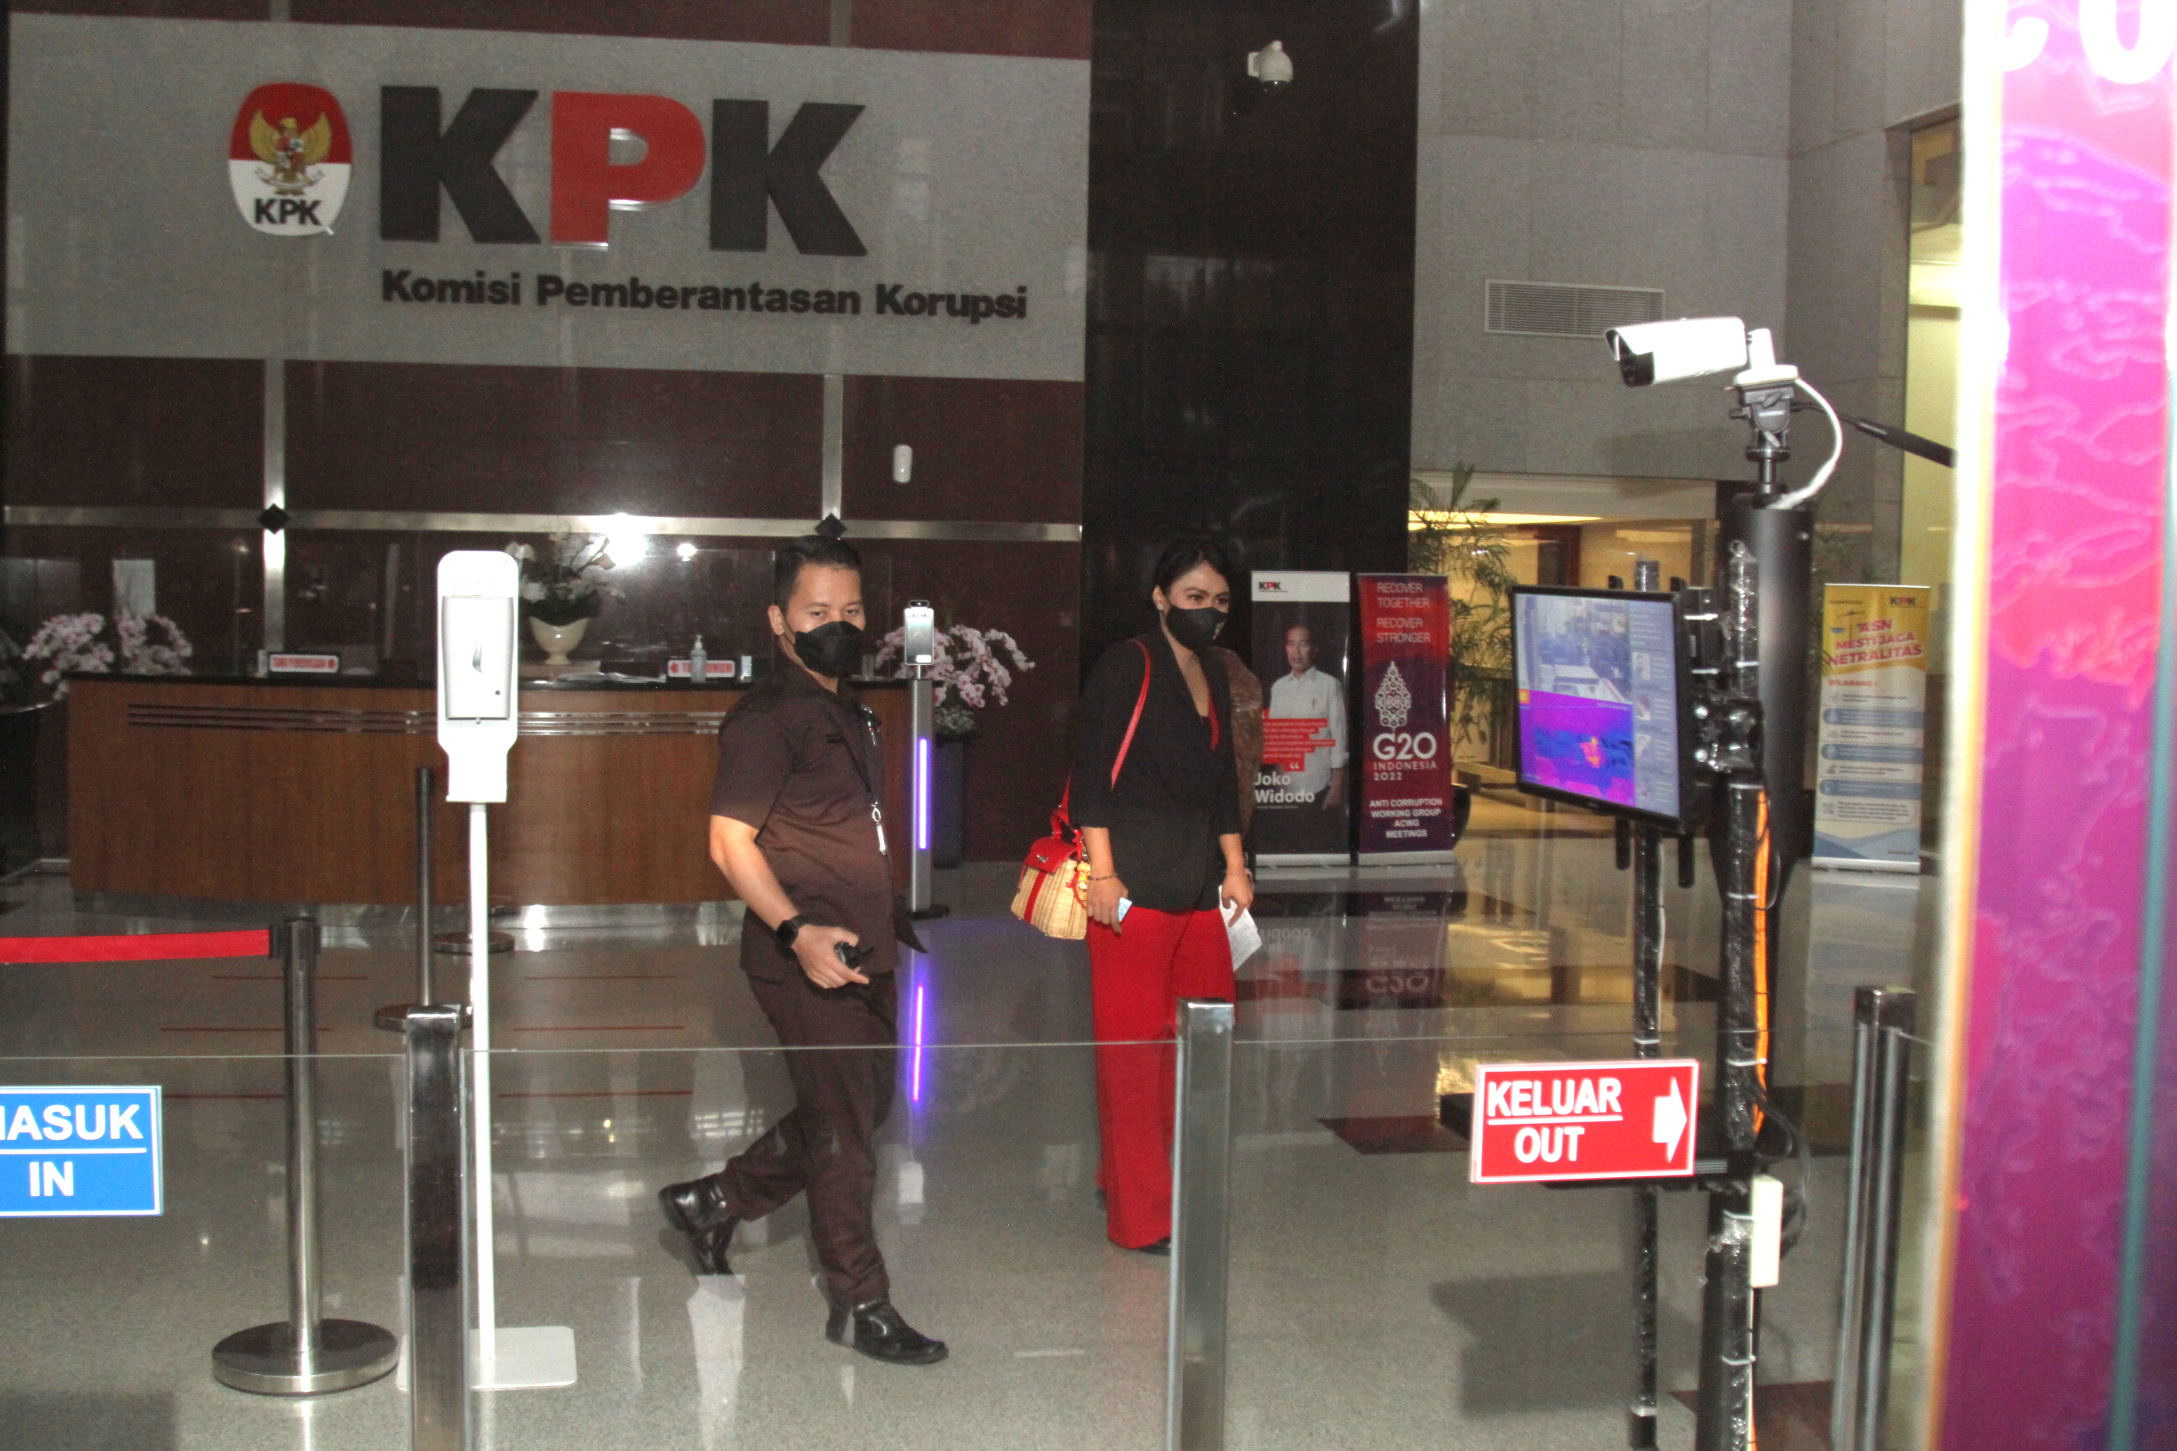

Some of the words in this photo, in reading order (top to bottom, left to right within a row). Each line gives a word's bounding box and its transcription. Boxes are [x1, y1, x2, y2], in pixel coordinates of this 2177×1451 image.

[380, 85, 869, 257] KPK
[254, 198, 322, 226] KPK
[381, 269, 521, 307] Komisi
[537, 274, 861, 315] Pemberantasan
[875, 282, 1027, 325] Korupsi
[1258, 581, 1282, 591] KPK
[1376, 582, 1423, 594] RECOVER
[1377, 597, 1430, 609] TOGETHER
[1376, 617, 1423, 629] RECOVER
[1859, 619, 1893, 633] ASN
[1376, 632, 1431, 644] STRONGER
[1836, 637, 1878, 651] MESTI
[1829, 644, 1922, 666] NETRALITAS
[1373, 731, 1437, 760] G20
[1373, 760, 1437, 771] INDONESIA
[1254, 771, 1291, 786] Joko
[1373, 772, 1403, 781] 2022
[1254, 789, 1315, 803] Widodo
[1390, 798, 1443, 807] CORRUPTION
[1371, 809, 1411, 818] WORKING
[1412, 808, 1441, 817] GROUP
[1386, 829, 1428, 838] MEETINGS
[1487, 1077, 1622, 1117] KELUAR
[0, 1104, 144, 1141] ASUK
[1514, 1126, 1585, 1164] OUT
[29, 1161, 74, 1197] IN
